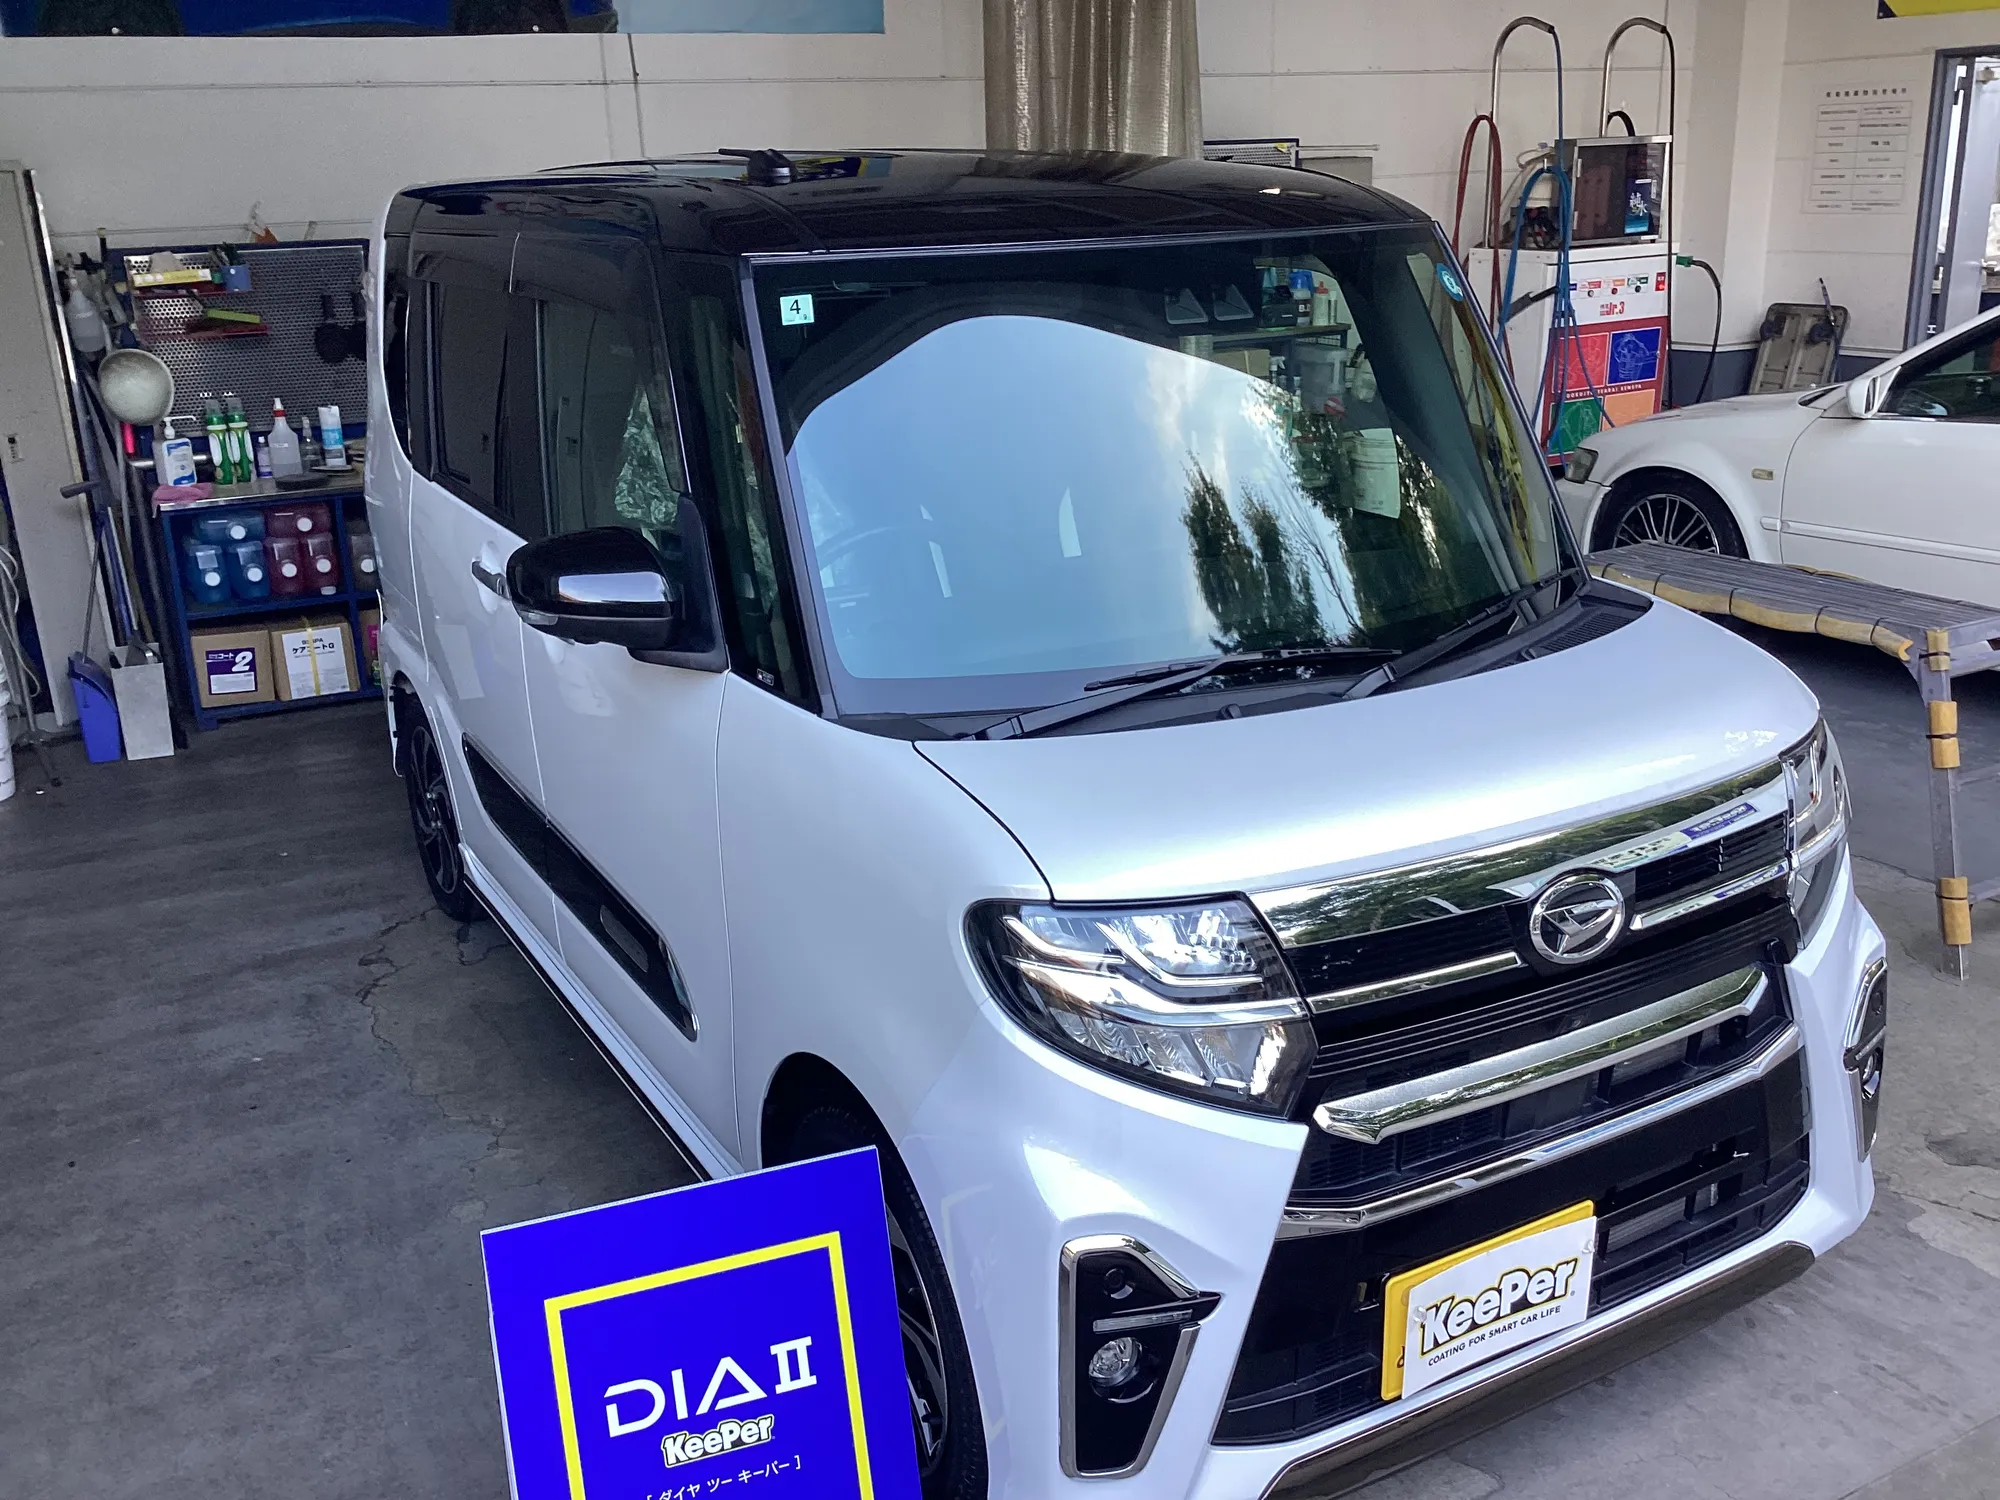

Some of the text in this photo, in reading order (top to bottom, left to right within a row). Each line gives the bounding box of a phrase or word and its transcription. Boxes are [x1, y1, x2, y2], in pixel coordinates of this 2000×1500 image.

[790, 299, 801, 314] 4
[231, 651, 253, 672] 2
[1419, 1258, 1579, 1357] KeePer
[1428, 1305, 1561, 1366] COATING FOR SMART CAR LIFE
[603, 1356, 768, 1438] DIA
[661, 1413, 774, 1468] KeePer
[737, 1460, 790, 1484] キーパー
